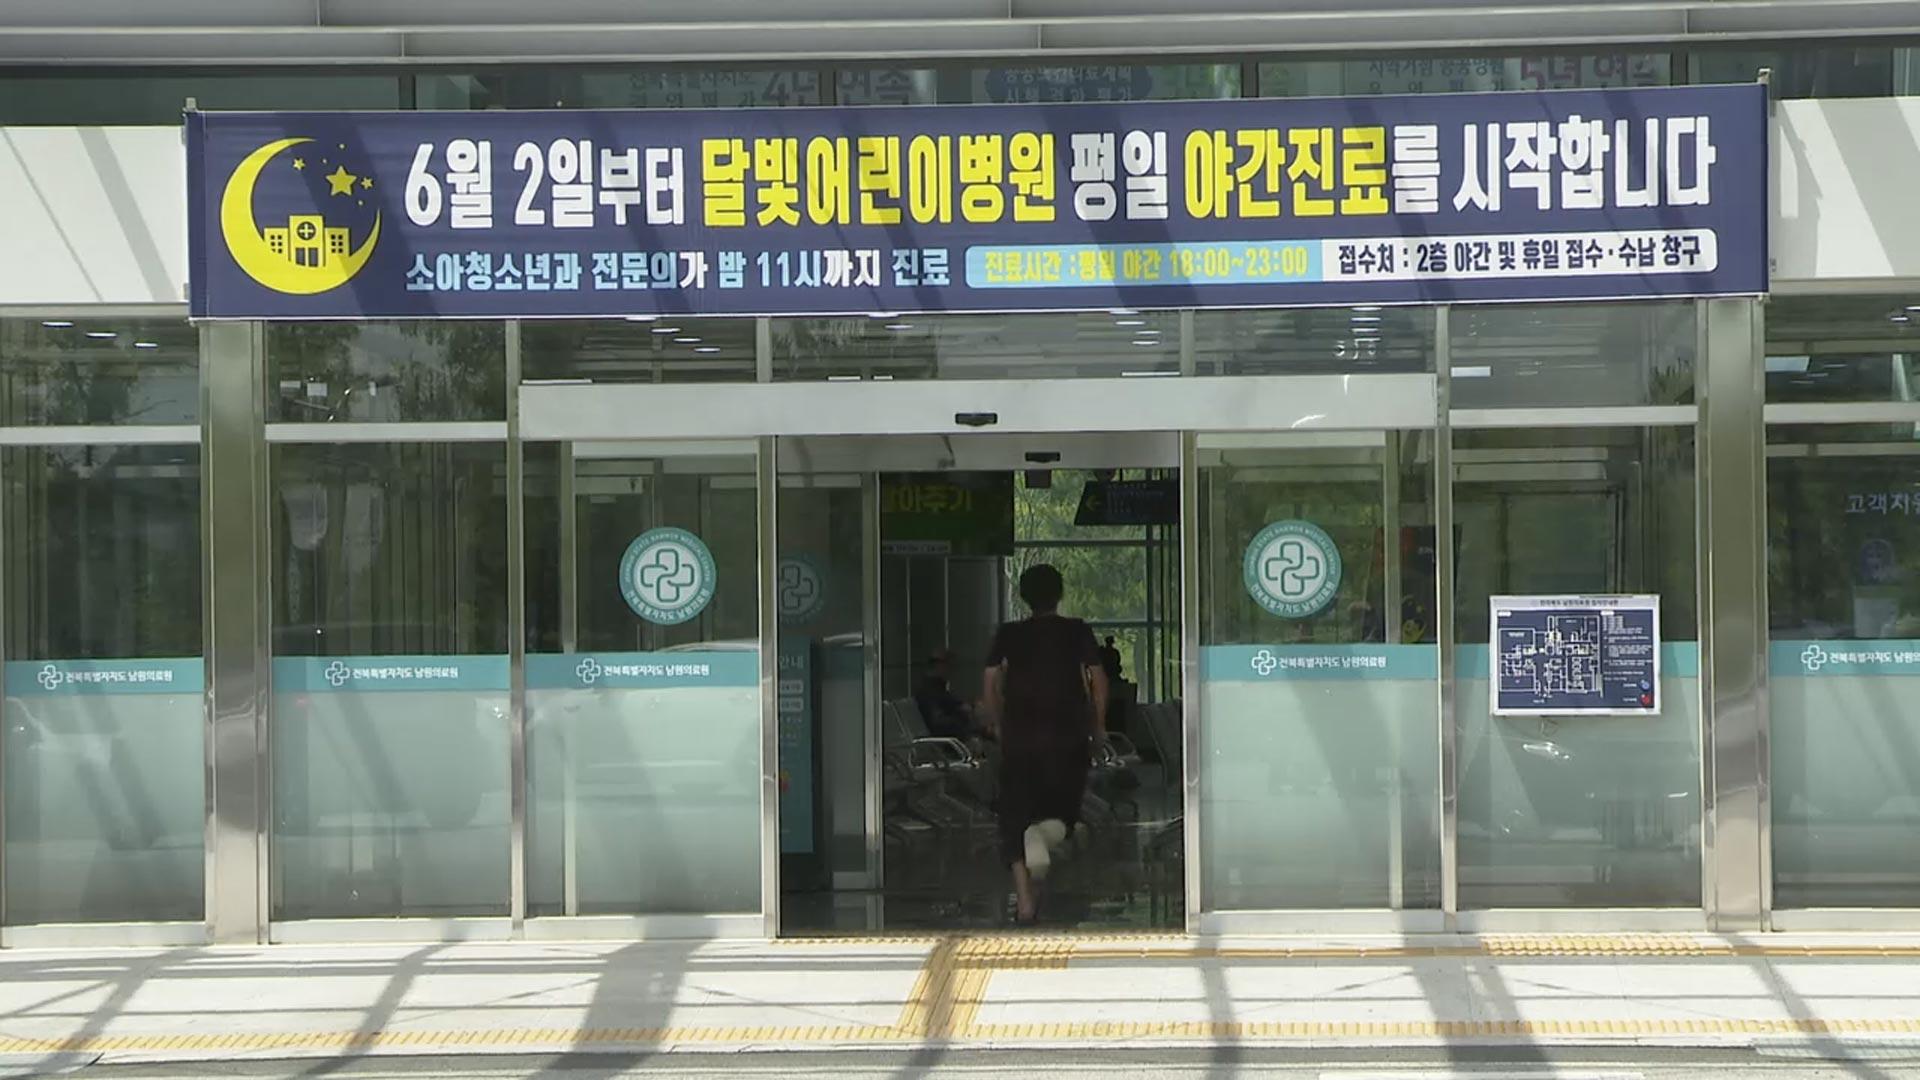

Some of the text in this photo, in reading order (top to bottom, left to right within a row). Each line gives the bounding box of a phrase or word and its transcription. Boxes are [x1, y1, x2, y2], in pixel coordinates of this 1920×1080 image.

[404, 114, 1717, 228] 6월 2일부터 달빛어린이병원 평일 야간진료를 시작합니다
[985, 251, 1061, 282] 진료시간
[1123, 249, 1162, 280] 야간
[1170, 247, 1308, 279] 18:00~23:00
[1338, 243, 1395, 274] 접수처
[1417, 243, 1448, 273] 2층
[1454, 242, 1492, 271] 야간
[1498, 240, 1516, 270] 및
[1523, 239, 1559, 270] 휴일
[1662, 235, 1701, 266] 창구
[406, 249, 951, 291] 소아청소년과 전문의가 밤 11시까지 진료
[353, 666, 458, 680] 전북특별자치도 남원의료원
[604, 663, 710, 676] 전북특별자치도 남원의료원
[1279, 655, 1387, 668] 전북특별자치도 남원의료원
[128, 669, 173, 683] 남원의료원
